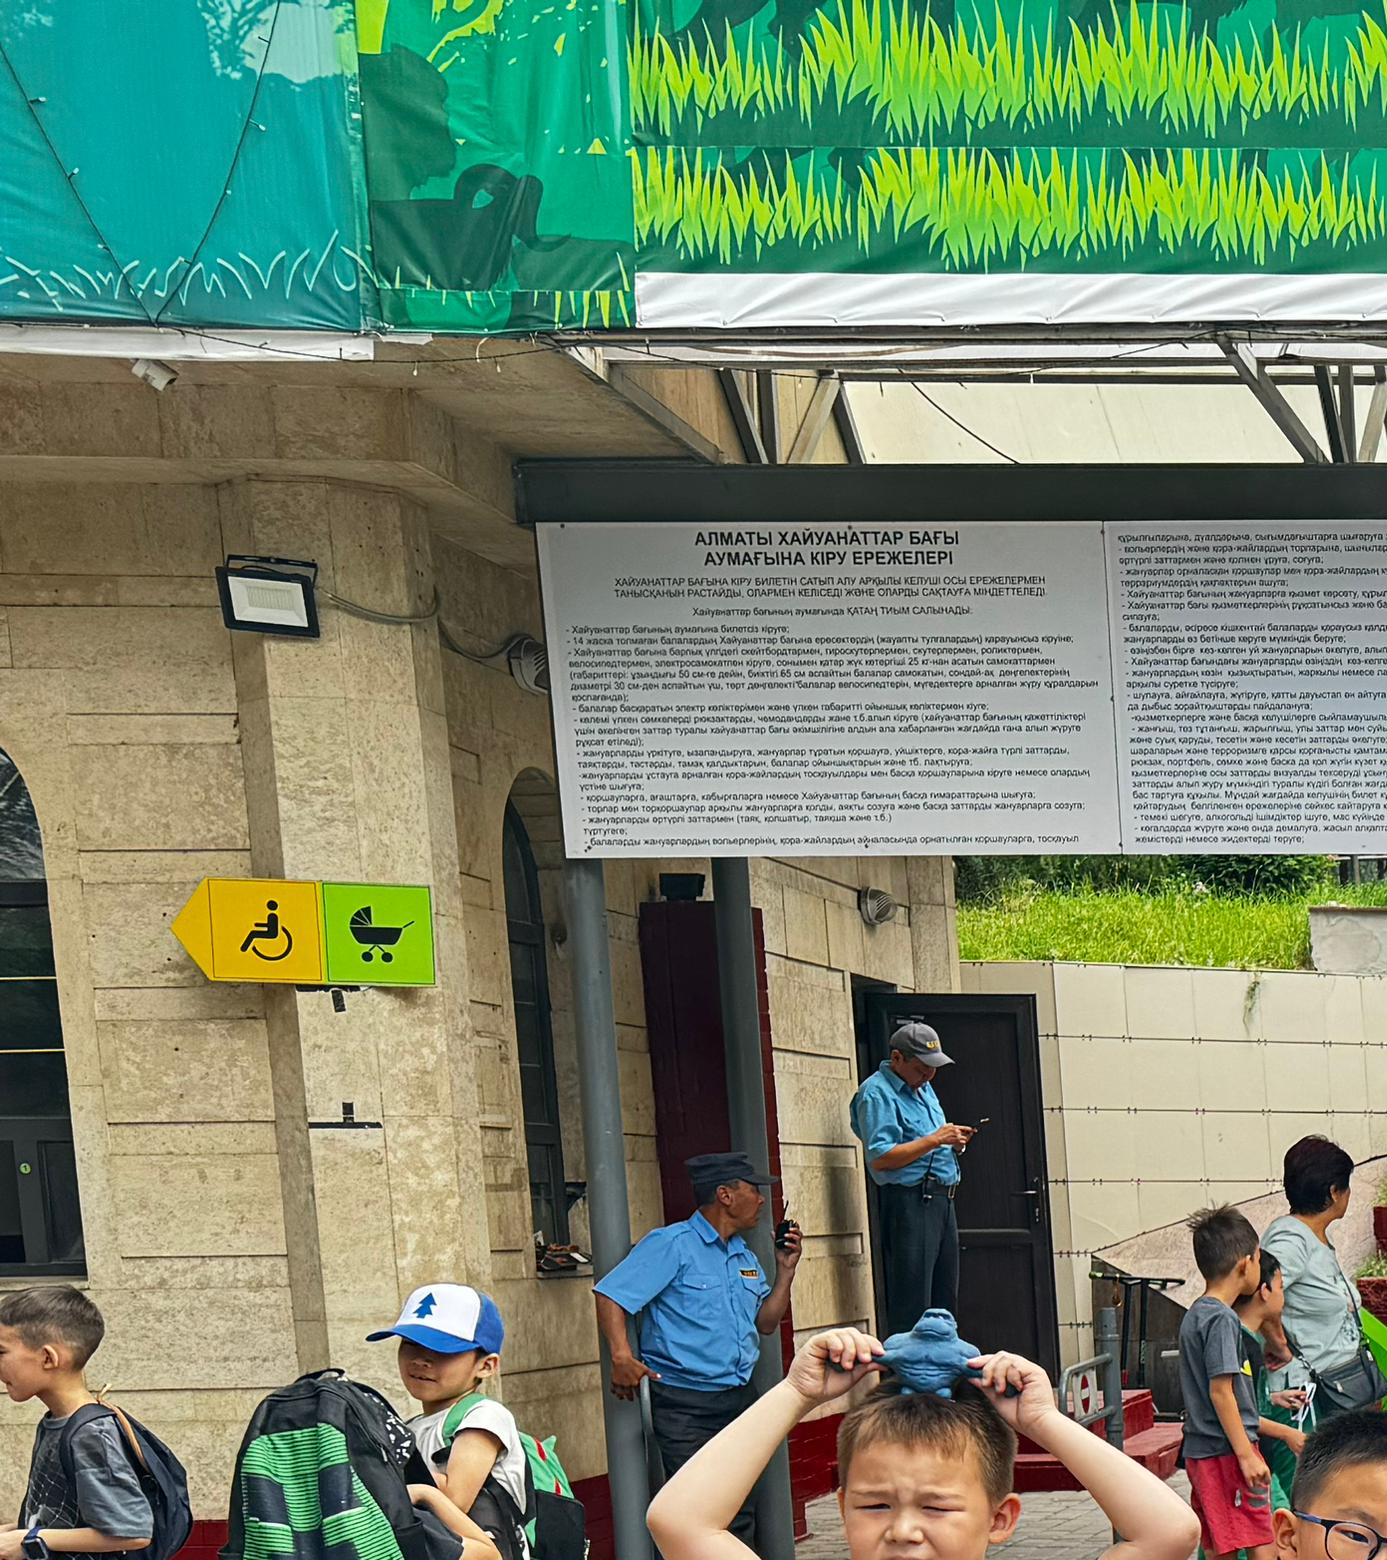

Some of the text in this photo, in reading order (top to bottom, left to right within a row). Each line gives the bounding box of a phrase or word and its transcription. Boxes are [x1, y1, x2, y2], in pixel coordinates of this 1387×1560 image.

[694, 528, 959, 546] АЛМАТЫ ХАЙУАНАТТАР БАҒЫ
[703, 550, 953, 566] АУМАҒЫНА КІРУ ЕРЕЖЕЛЕРІ
